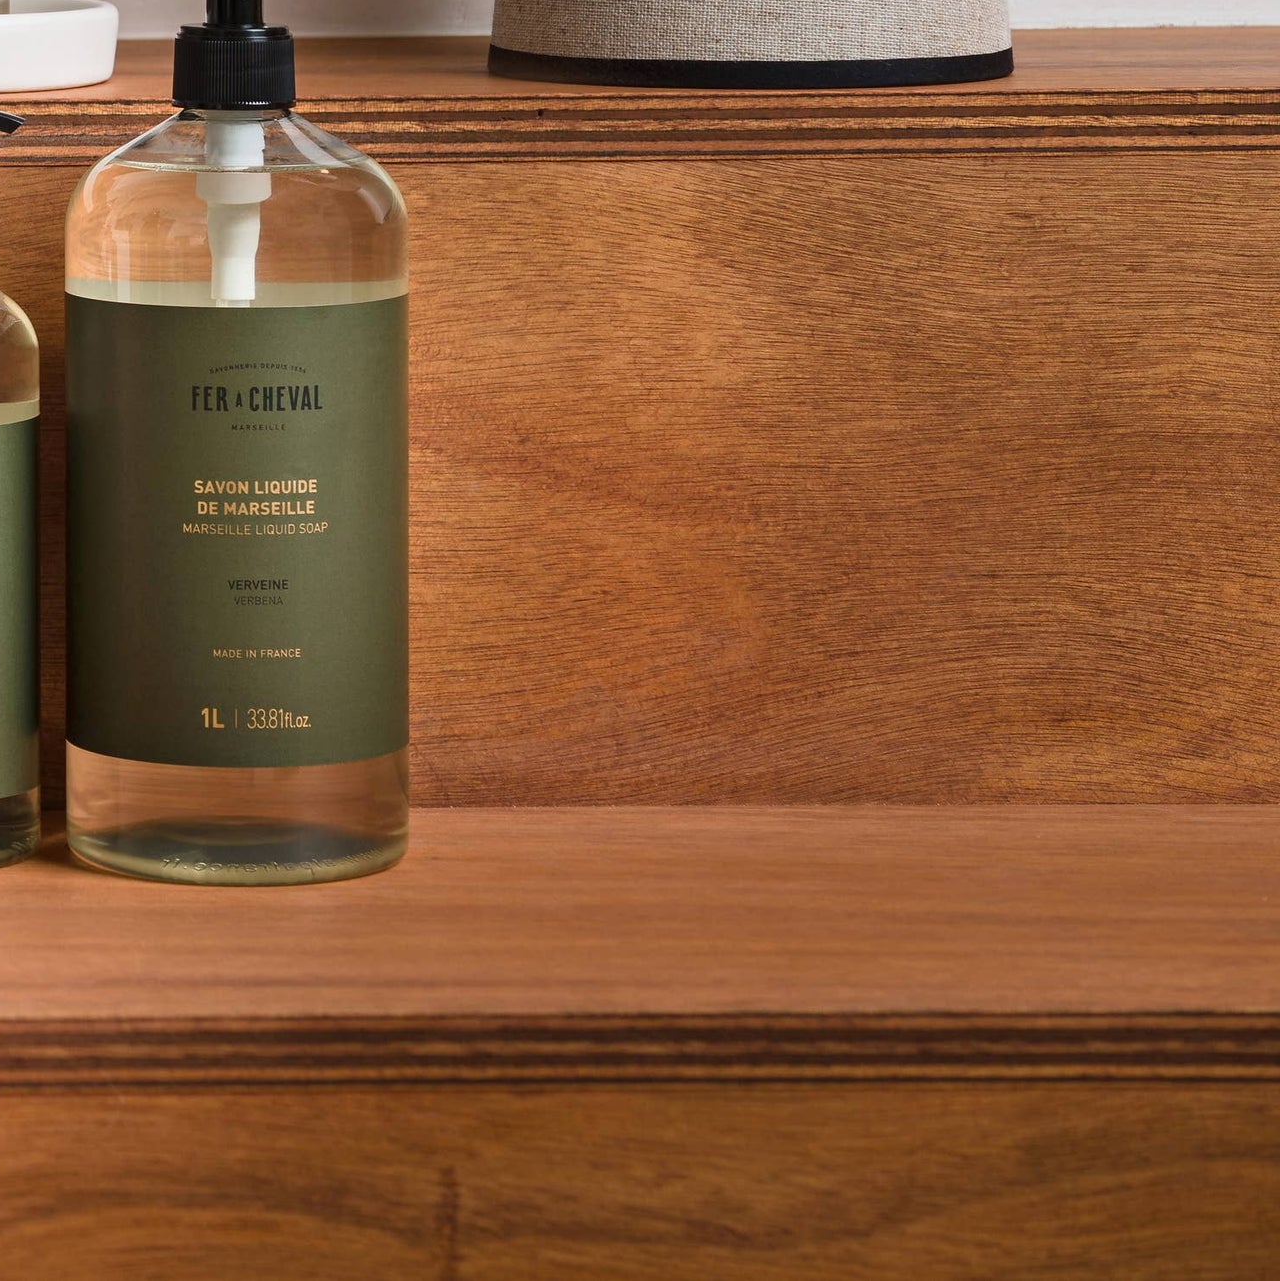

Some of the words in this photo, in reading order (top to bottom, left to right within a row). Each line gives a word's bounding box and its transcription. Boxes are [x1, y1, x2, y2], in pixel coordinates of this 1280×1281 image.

[191, 385, 229, 412] FER
[249, 384, 324, 412] CHEVAL
[231, 423, 286, 431] MARSEILLE
[193, 479, 249, 495] SAVON
[254, 478, 318, 495] LIQUIDE
[197, 501, 219, 515] DE
[223, 500, 315, 516] MARSEILLE
[182, 522, 252, 536] MARSEILLE
[255, 523, 296, 536] LIQUID
[298, 521, 329, 534] SOAP
[227, 578, 289, 591] VERVEINE
[233, 595, 284, 606] VERBENA
[213, 648, 242, 659] MADE
[245, 649, 257, 658] IN
[260, 648, 302, 658] FRANCE
[201, 708, 225, 729] 1L
